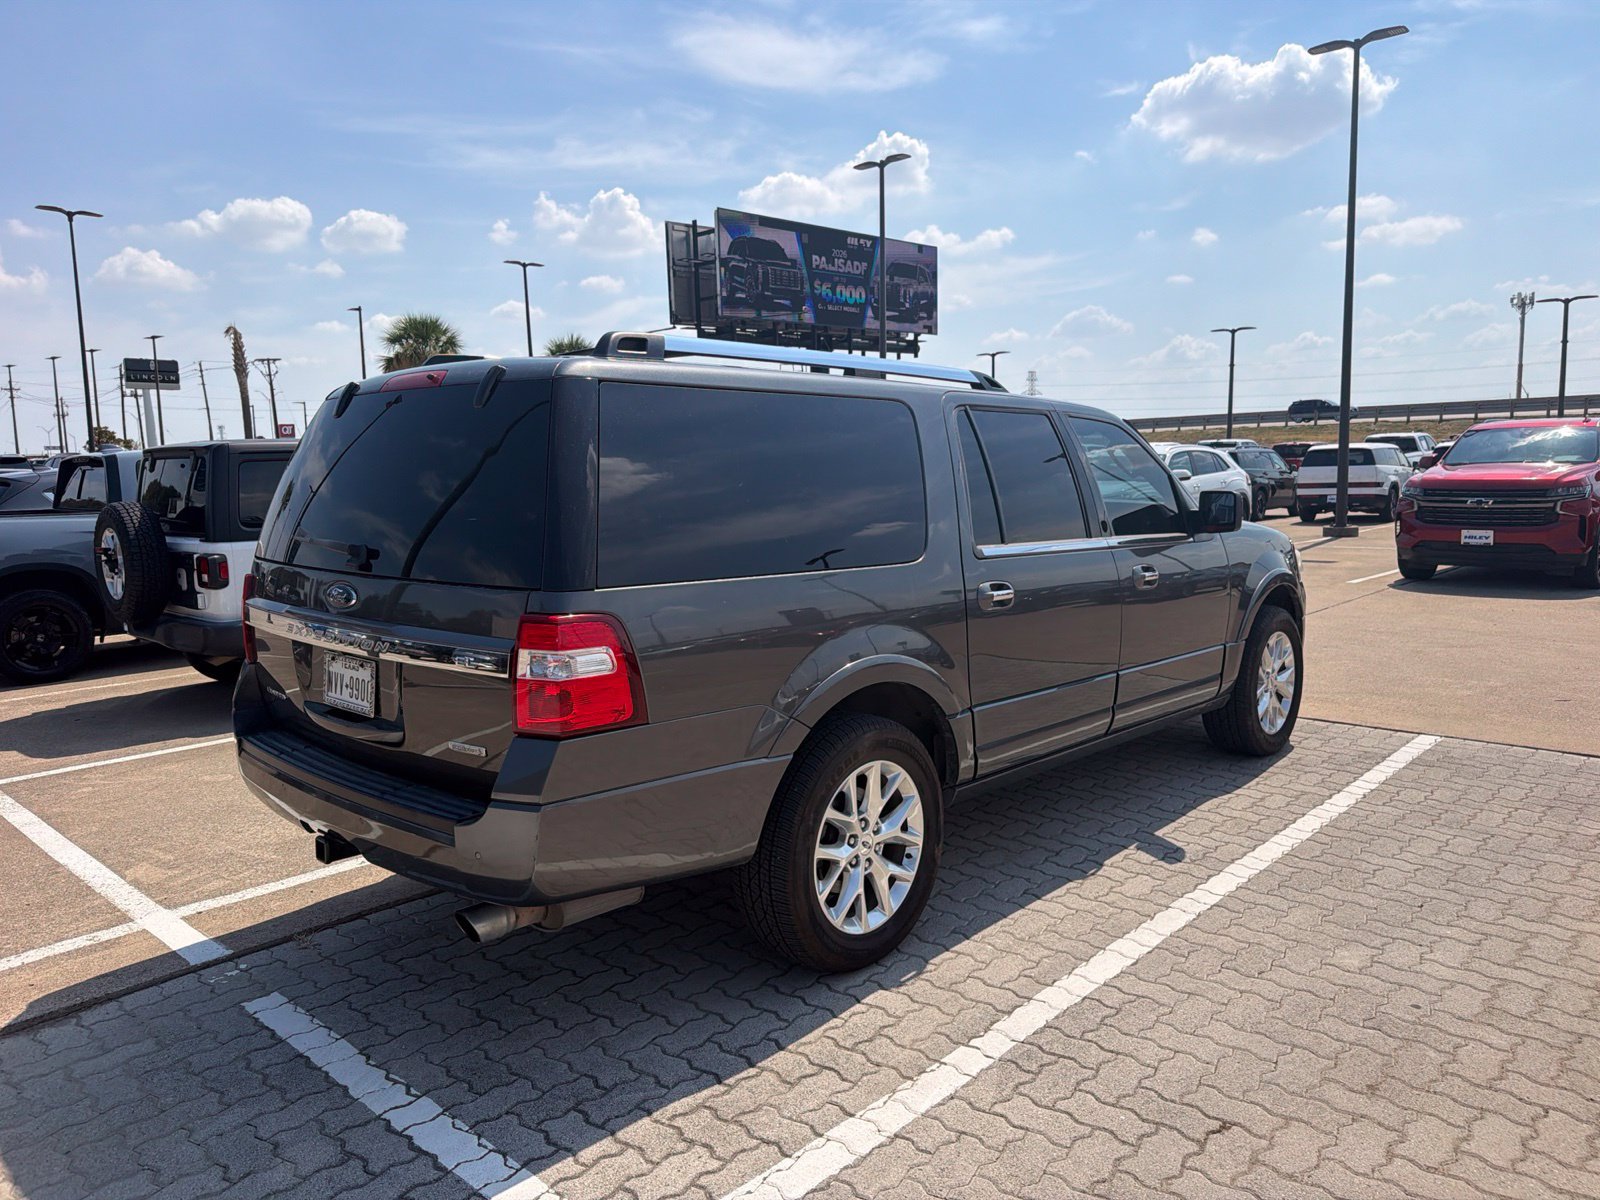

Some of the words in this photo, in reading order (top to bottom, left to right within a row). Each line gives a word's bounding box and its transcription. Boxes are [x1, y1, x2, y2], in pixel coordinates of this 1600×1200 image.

[832, 248, 848, 259] 2026
[130, 373, 176, 381] LINCOLN
[281, 425, 293, 435] QT
[286, 622, 390, 652] EXPEDITION
